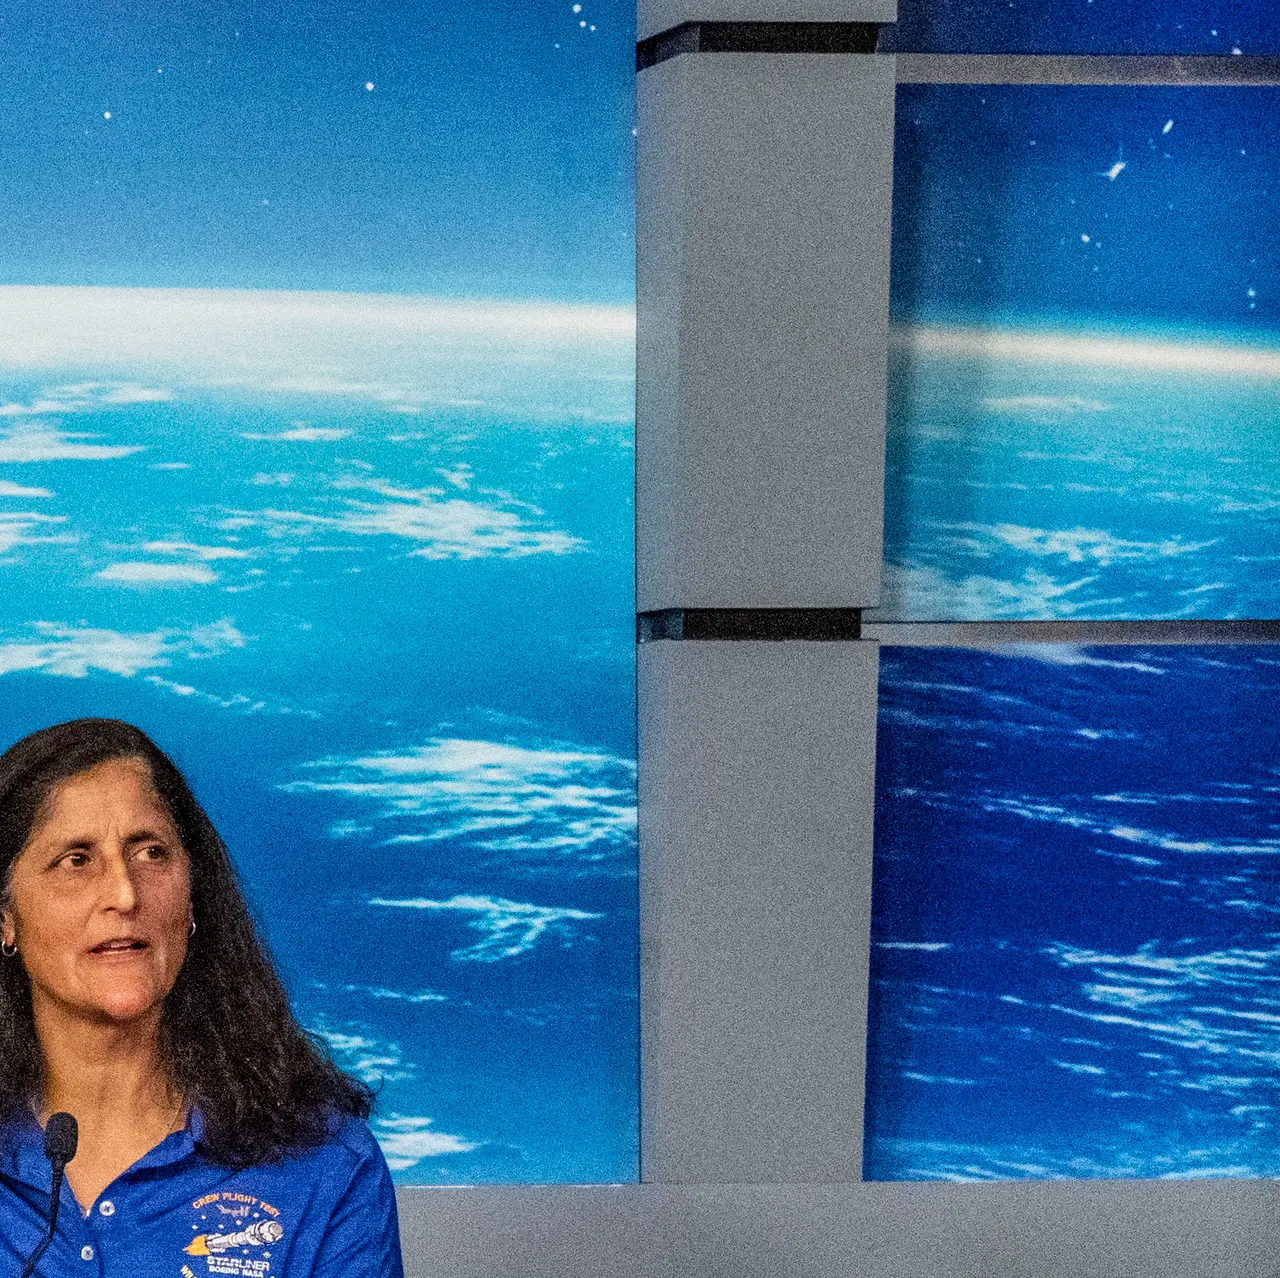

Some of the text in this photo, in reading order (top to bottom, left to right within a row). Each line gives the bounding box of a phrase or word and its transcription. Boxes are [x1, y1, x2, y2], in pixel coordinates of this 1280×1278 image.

[192, 1192, 280, 1217] CREW FLIGHT TEST
[207, 1256, 270, 1271] STARLINER
[209, 1265, 264, 1278] BOEING NASA
